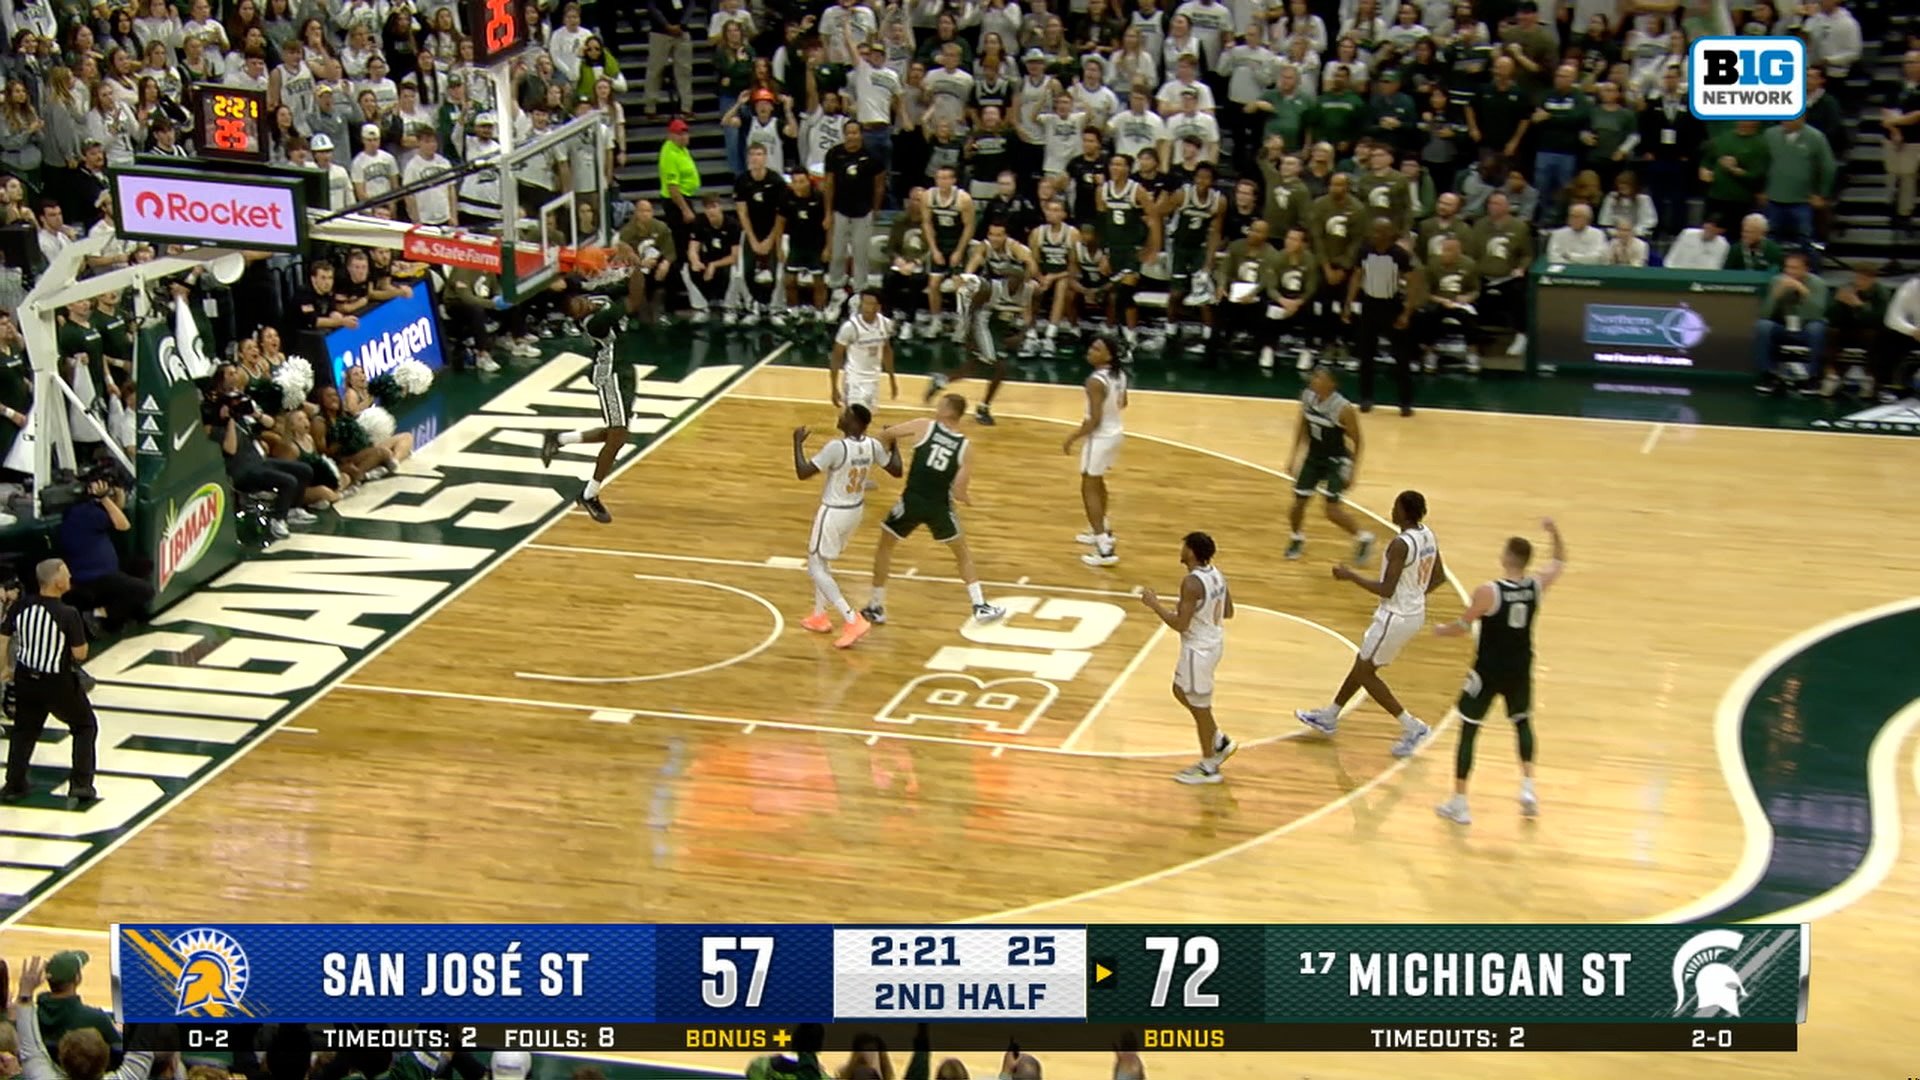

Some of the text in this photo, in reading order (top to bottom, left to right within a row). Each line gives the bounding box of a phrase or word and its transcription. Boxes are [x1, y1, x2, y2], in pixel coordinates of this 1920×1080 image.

[213, 95, 259, 119] 2:21
[214, 118, 249, 150] 25
[166, 192, 284, 230] Rocket
[361, 316, 433, 382] McLaren
[926, 443, 954, 471] 15
[846, 466, 868, 494] 32
[159, 490, 218, 592] LIBMAN
